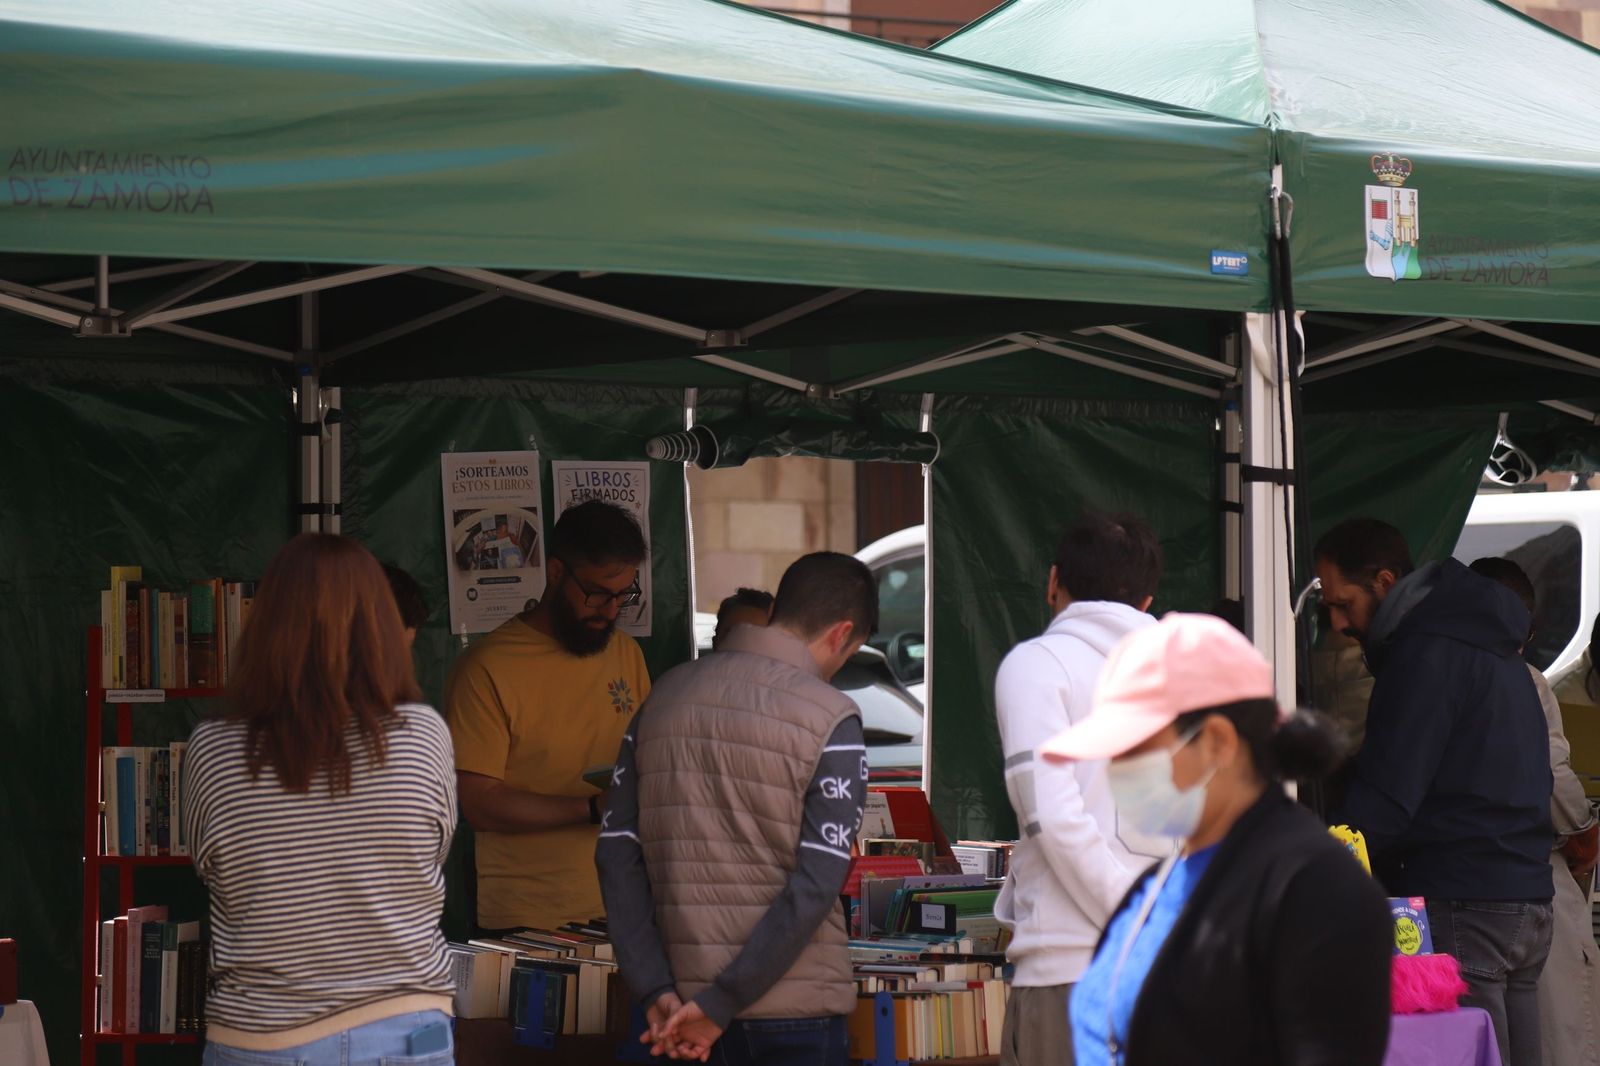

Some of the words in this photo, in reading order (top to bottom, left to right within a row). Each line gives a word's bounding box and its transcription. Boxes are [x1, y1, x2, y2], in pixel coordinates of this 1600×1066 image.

[8, 147, 212, 179] AYUNTAMIENTO
[8, 176, 53, 208] DE
[64, 178, 214, 214] ZAMORA
[1427, 234, 1549, 259] AYUNTAMIENTO
[1427, 256, 1452, 280] DE
[1459, 258, 1550, 286] ZAMORA
[455, 465, 529, 480] ¡SORTEAMOS
[574, 471, 631, 488] LIBROS
[452, 480, 490, 493] ESTOS
[571, 488, 636, 502] FIRMADOS
[820, 777, 852, 800] GK
[821, 822, 851, 848] GK
